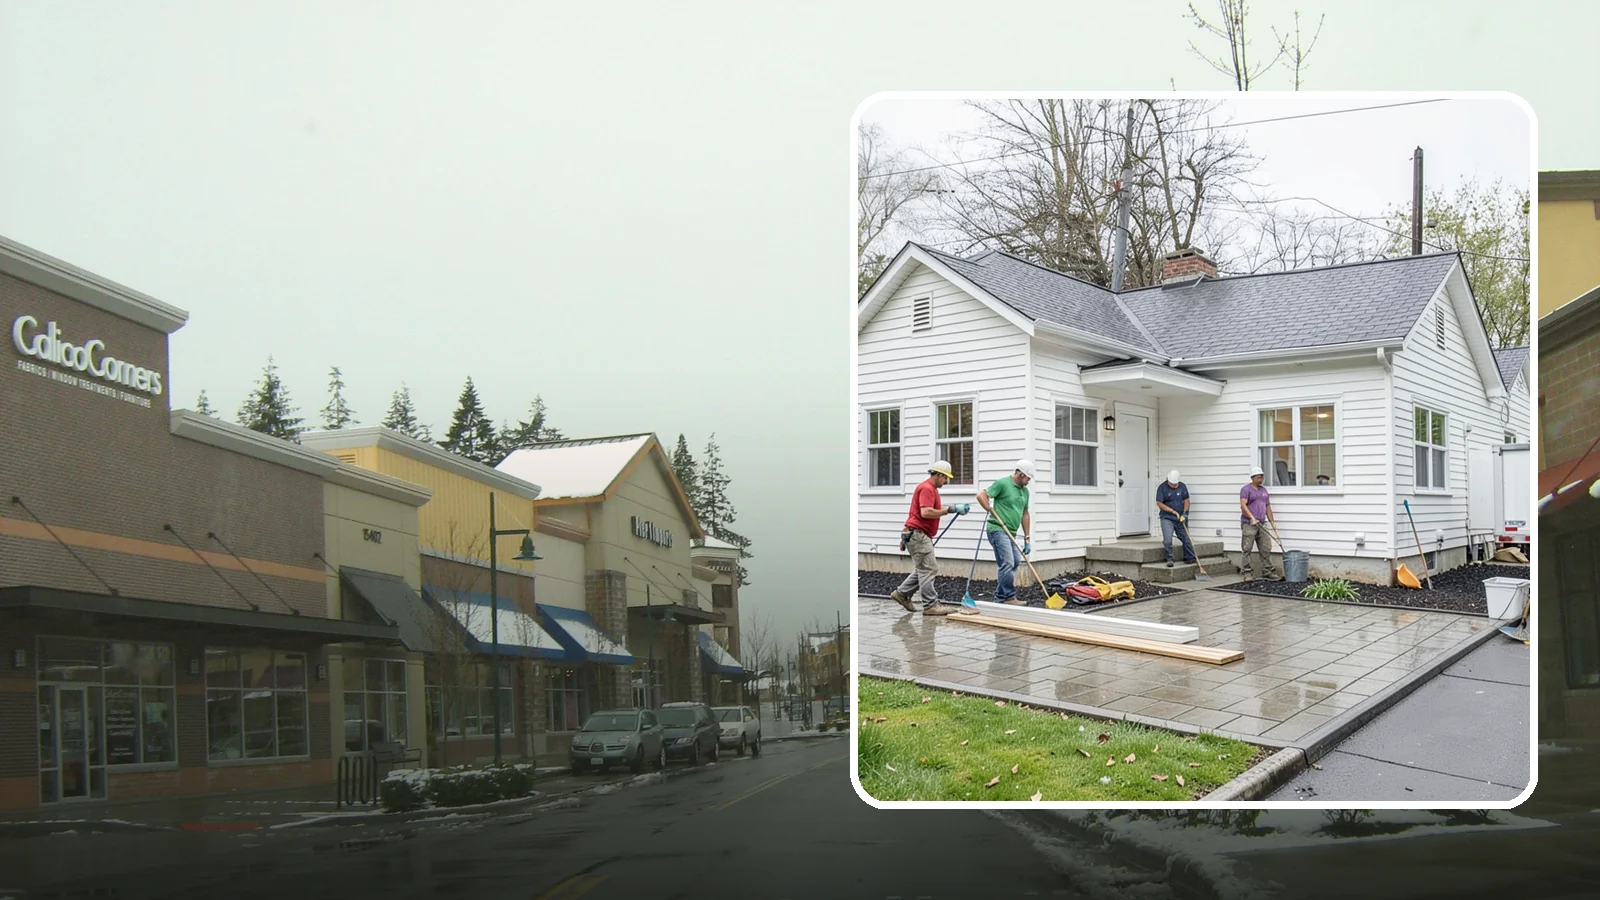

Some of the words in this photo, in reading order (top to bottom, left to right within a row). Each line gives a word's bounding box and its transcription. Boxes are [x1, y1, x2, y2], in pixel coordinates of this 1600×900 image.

[17, 360, 47, 377] FABRICS
[51, 370, 78, 386] WINDOW
[79, 379, 116, 398] TREATMENTS
[120, 391, 151, 408] FURNITURE
